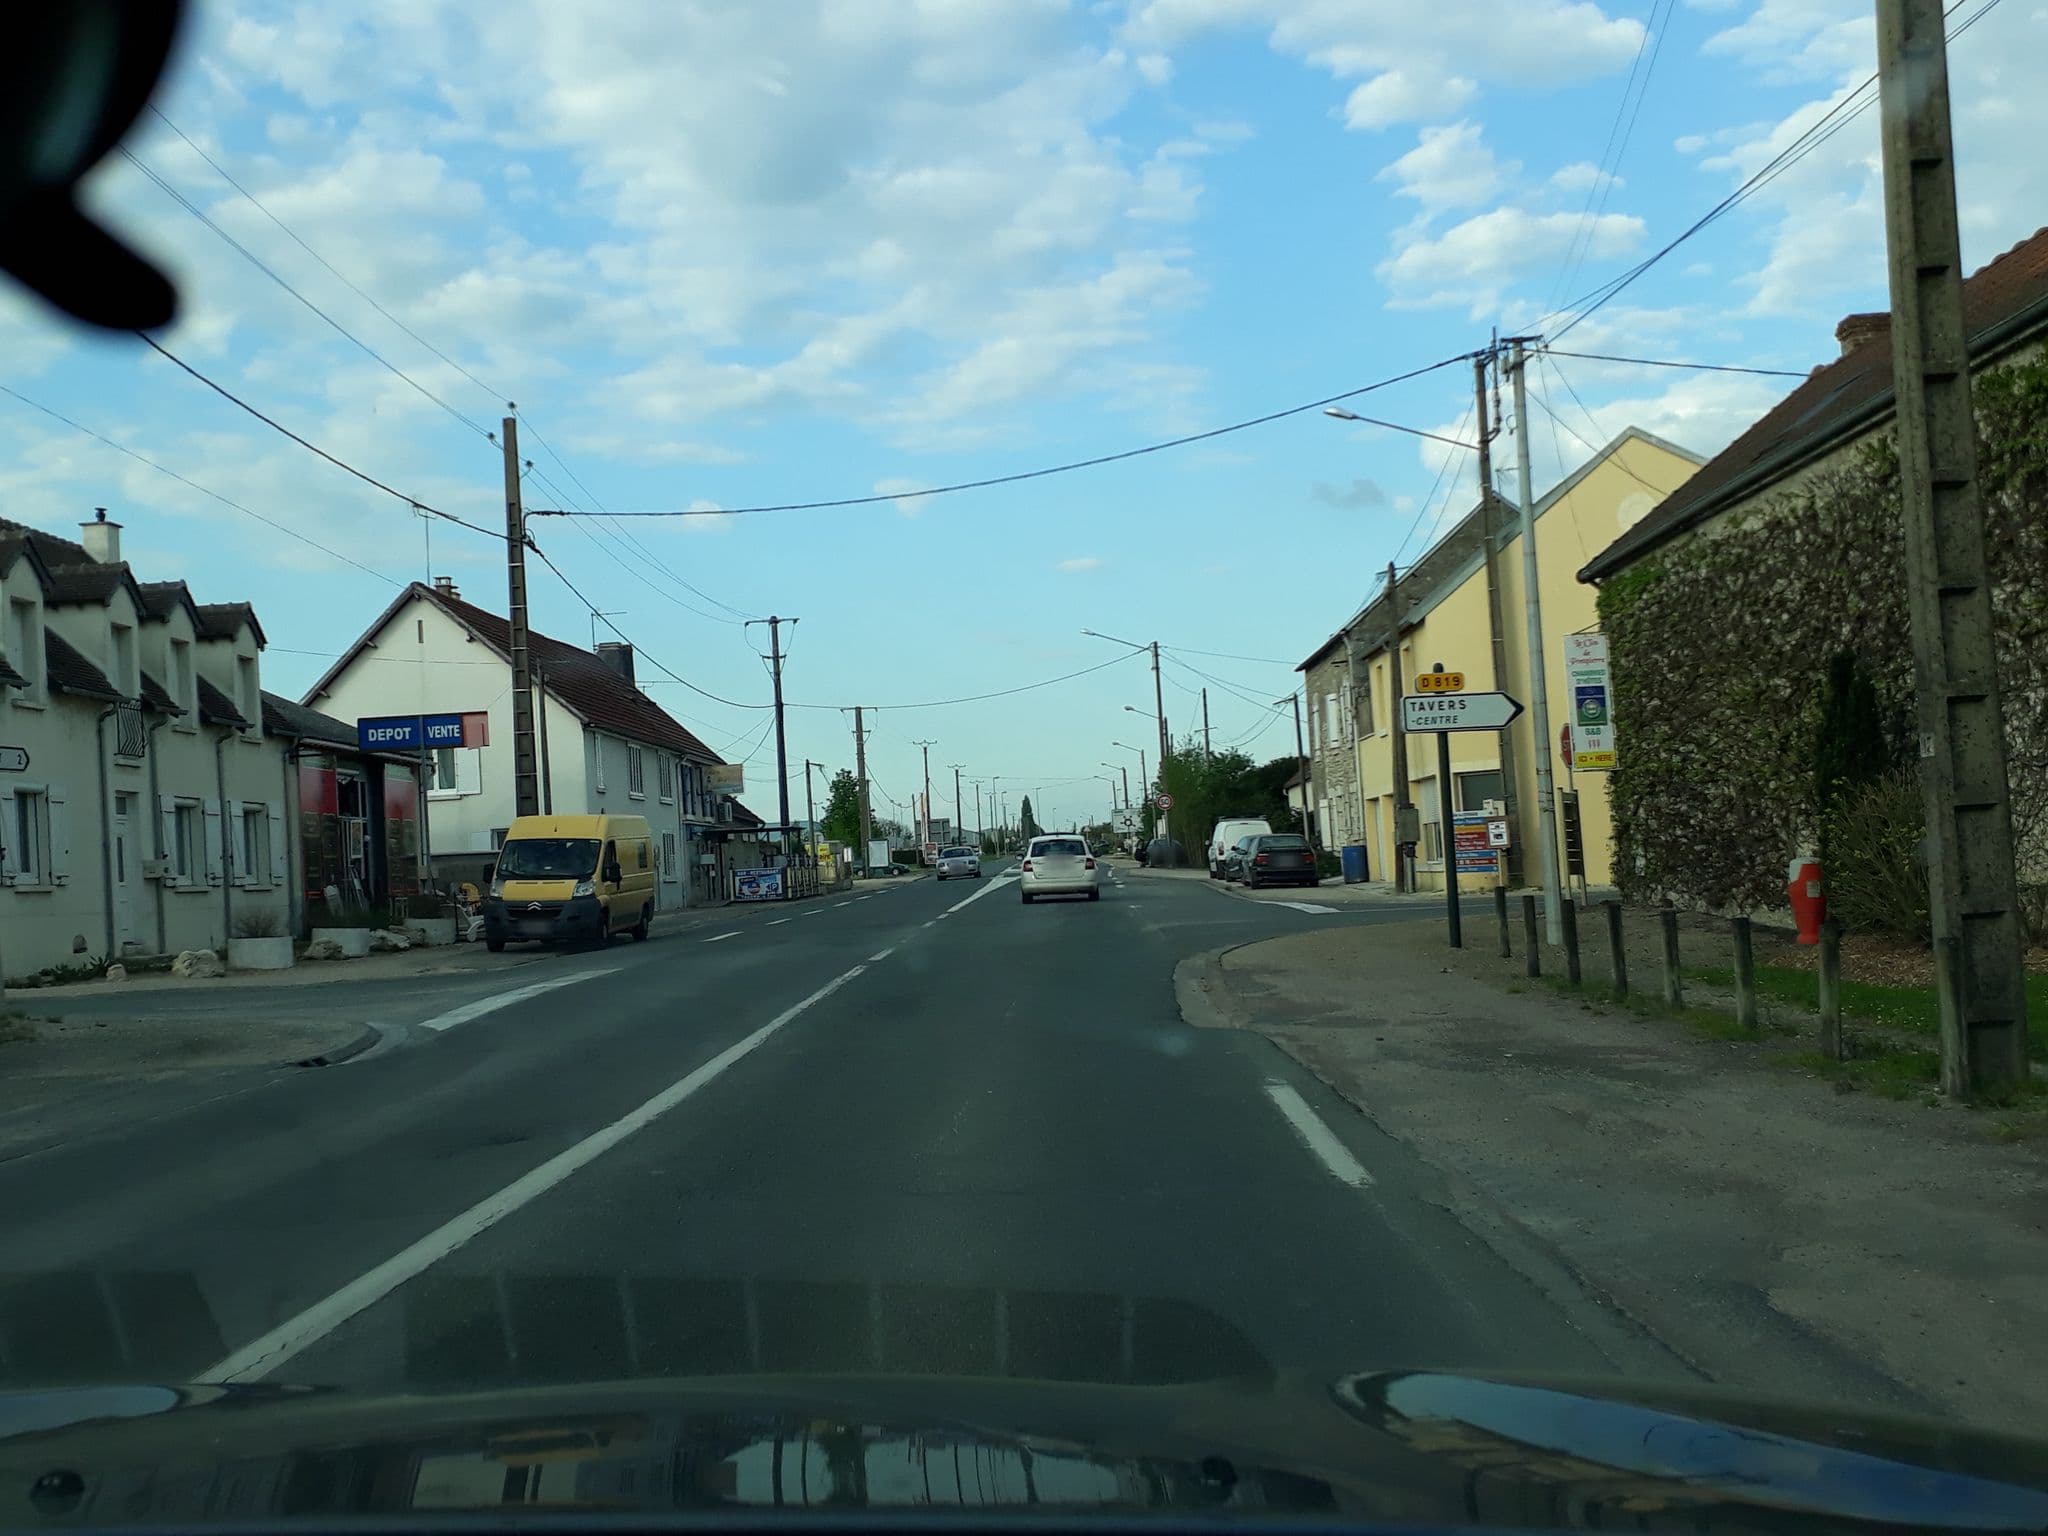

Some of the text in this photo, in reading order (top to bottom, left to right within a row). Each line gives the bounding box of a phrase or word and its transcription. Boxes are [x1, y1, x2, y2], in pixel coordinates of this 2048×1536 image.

[1422, 676, 1461, 688] D 819
[1410, 699, 1467, 712] TAVERS
[368, 724, 460, 742] DEPOT VENTE
